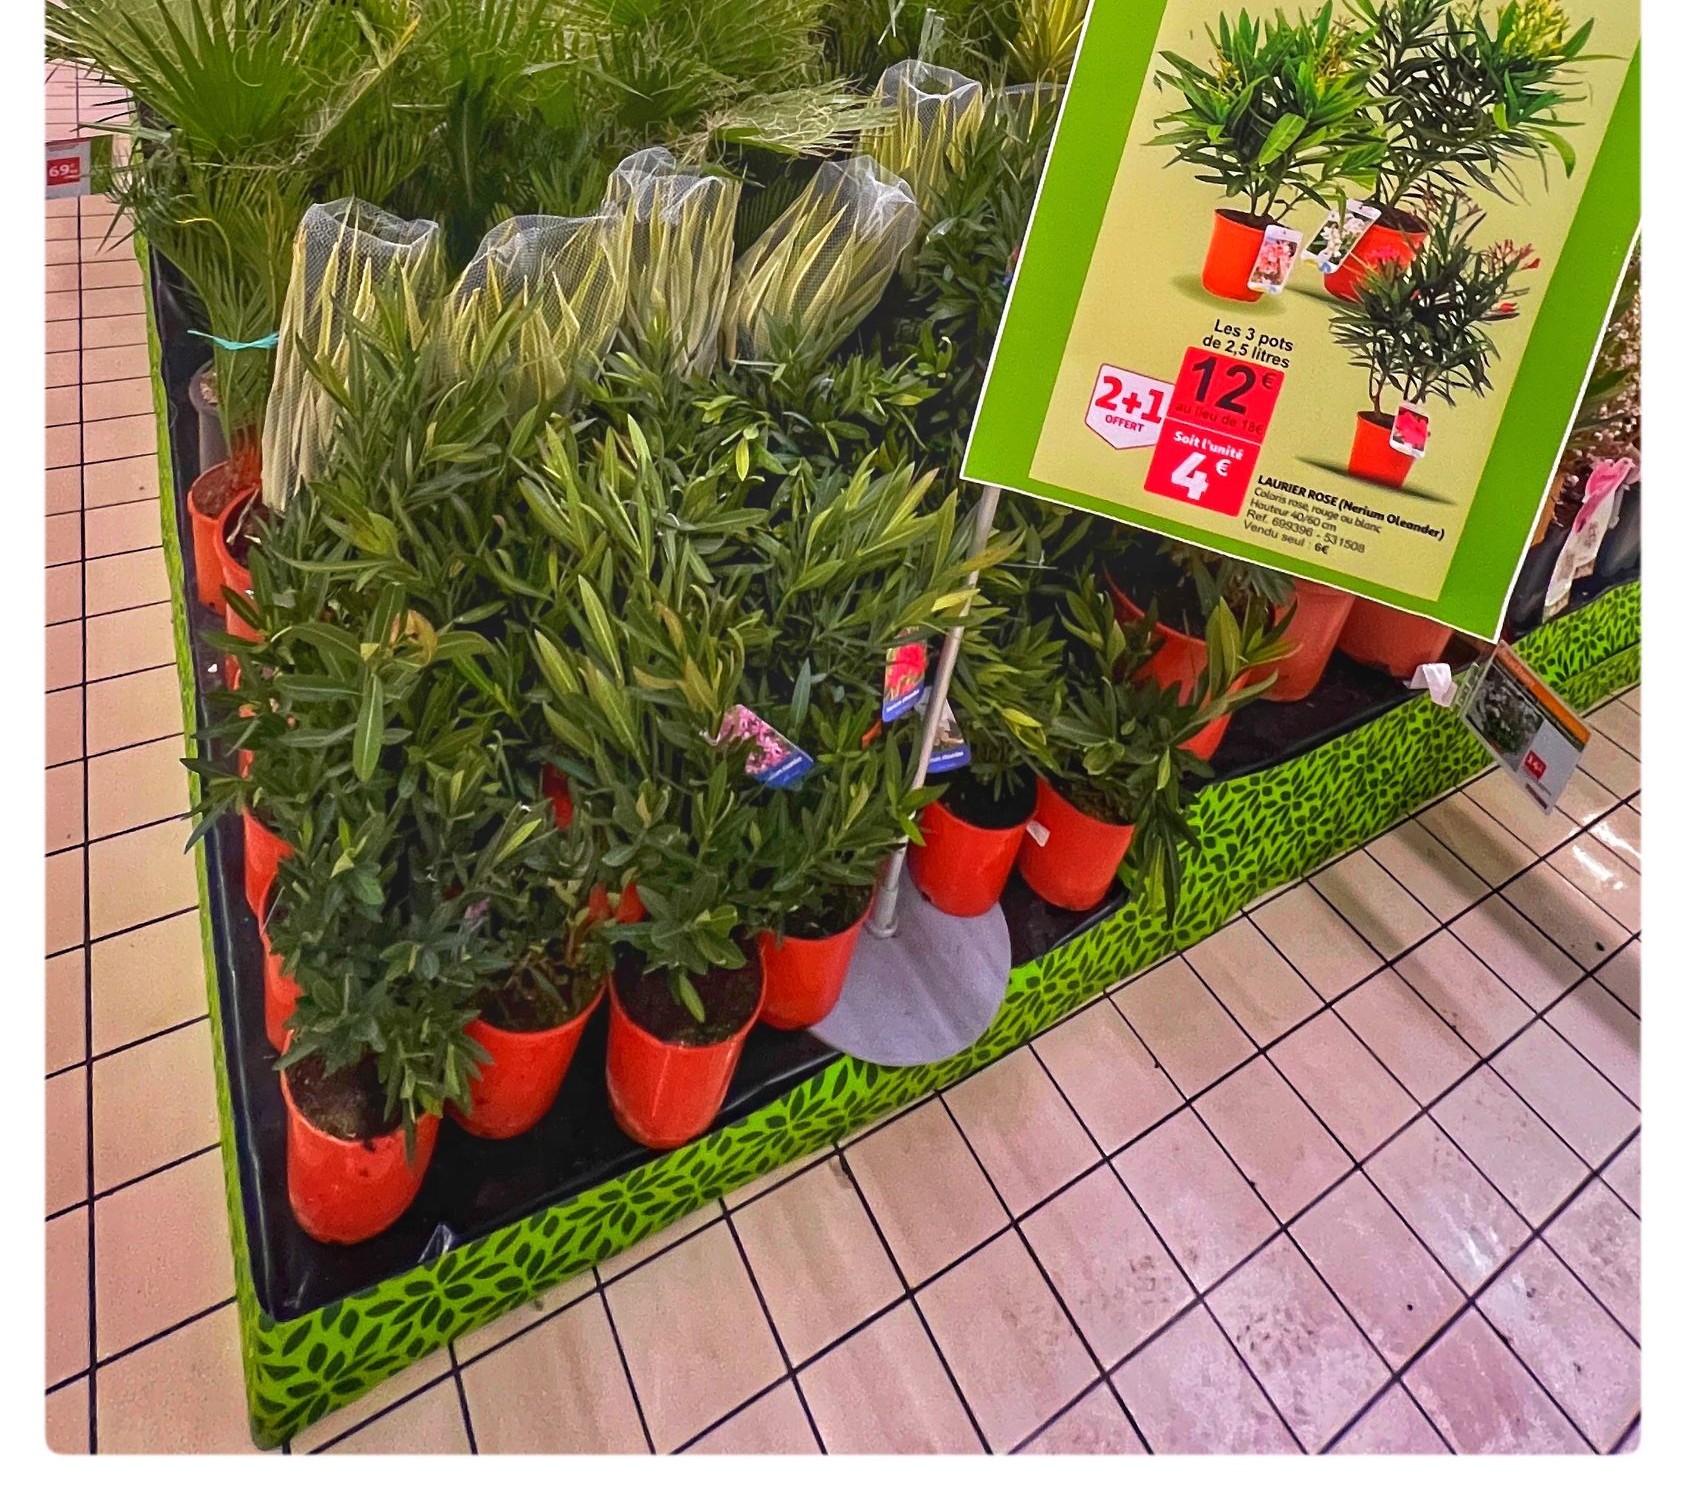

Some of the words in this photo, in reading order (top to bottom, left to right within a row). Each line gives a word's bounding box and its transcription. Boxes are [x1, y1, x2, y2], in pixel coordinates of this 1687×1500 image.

[1202, 335, 1221, 349] de
[1224, 340, 1249, 357] 2,5
[1252, 346, 1290, 369] litres
[1214, 319, 1242, 338] Les
[1245, 328, 1256, 341] 3
[1258, 334, 1294, 352] pots
[1095, 376, 1164, 424] 2+1
[1175, 403, 1191, 415] au
[1194, 405, 1218, 422] lieu
[1221, 414, 1237, 428] de
[1105, 414, 1145, 432] OFFERT
[1173, 431, 1200, 447] Soit
[1202, 437, 1244, 460] l'unité
[1250, 498, 1290, 516] Hauteur
[1321, 521, 1337, 532] cm
[1254, 487, 1286, 504] Coloris
[1311, 505, 1339, 520] rouge
[1340, 514, 1353, 525] ou
[1354, 517, 1382, 534] blanc
[1258, 474, 1307, 498] LAURIER
[1308, 490, 1339, 507] ROSE
[1338, 498, 1385, 521] (Nerium
[1386, 513, 1445, 542] Oleander)
[1244, 519, 1279, 539] Vendu
[1281, 533, 1305, 547] seul
[1314, 542, 1330, 555] 6€
